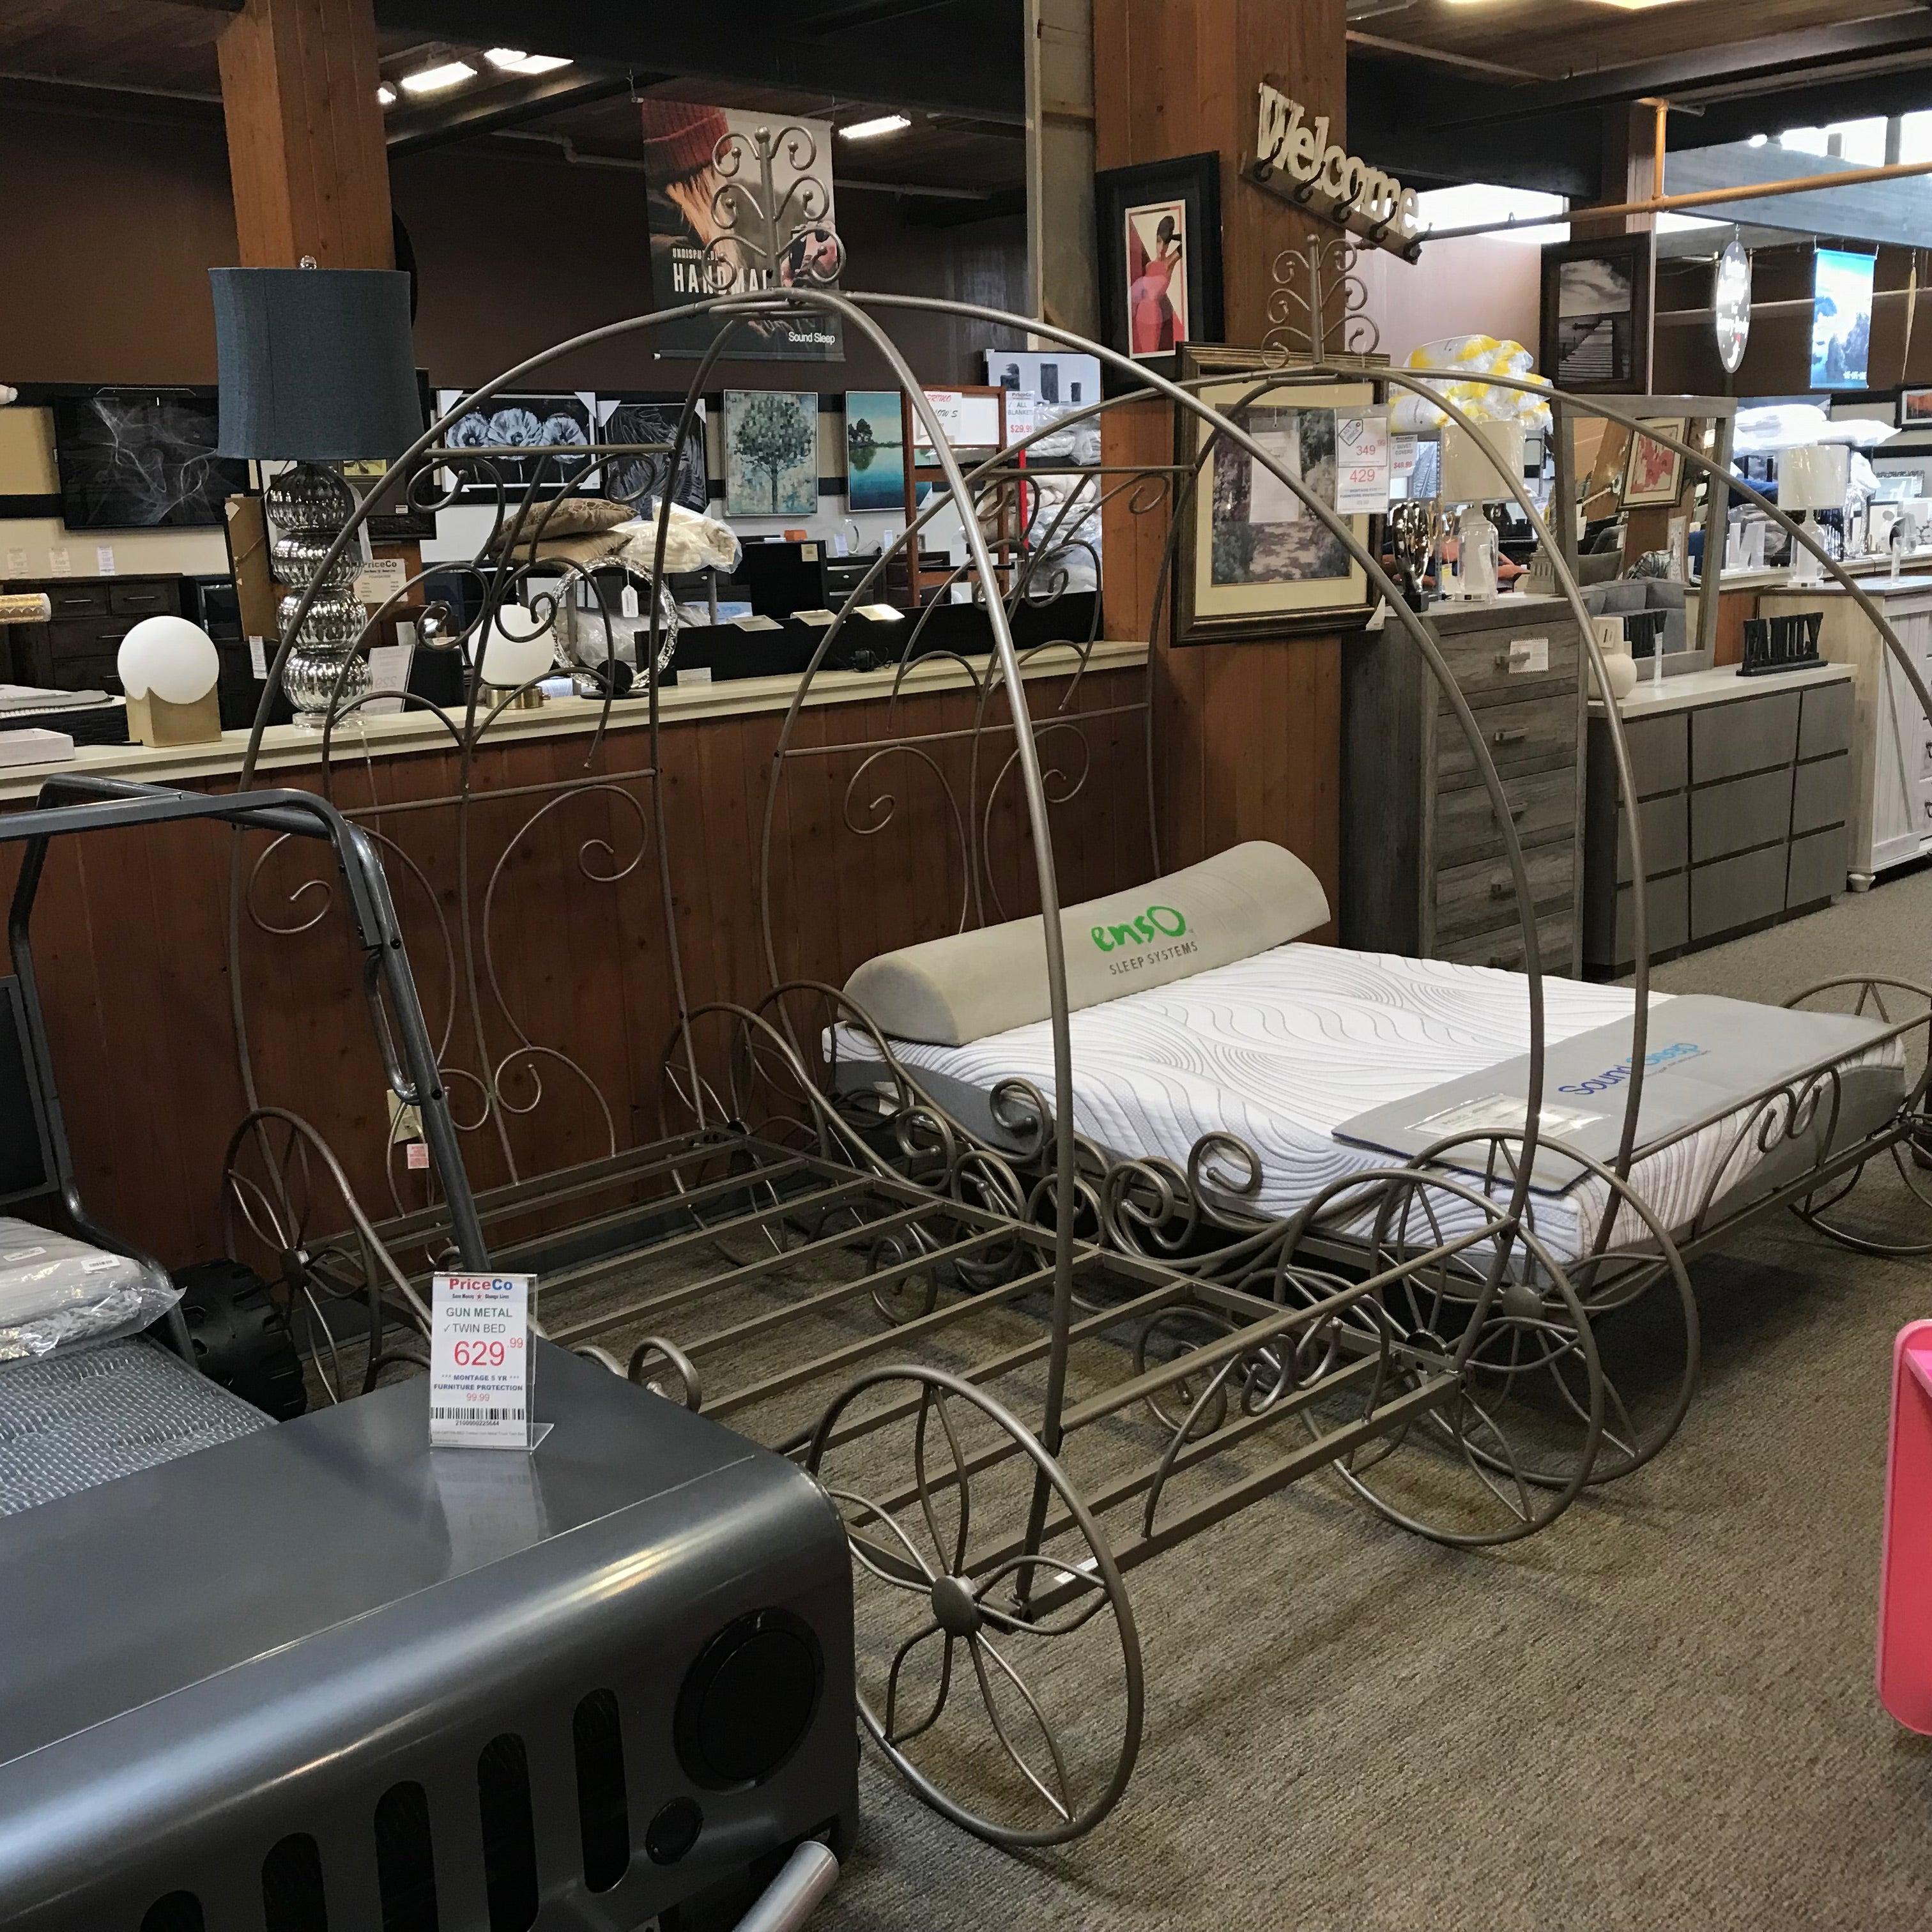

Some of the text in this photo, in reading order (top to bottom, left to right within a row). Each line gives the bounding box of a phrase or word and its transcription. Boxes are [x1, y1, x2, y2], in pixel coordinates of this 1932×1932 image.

[1257, 82, 1419, 239] Welcome
[788, 331, 836, 346] Sound Sleep
[1356, 445, 1376, 456] 349
[1349, 468, 1376, 482] 429
[1109, 940, 1199, 975] SLEEP SYSTEMS
[449, 1278, 513, 1291] PriceCo
[446, 1307, 513, 1317] GUN METAL
[452, 1323, 506, 1333] TWIN BED
[454, 1340, 505, 1367] 629
[466, 1393, 490, 1402] 99.99
